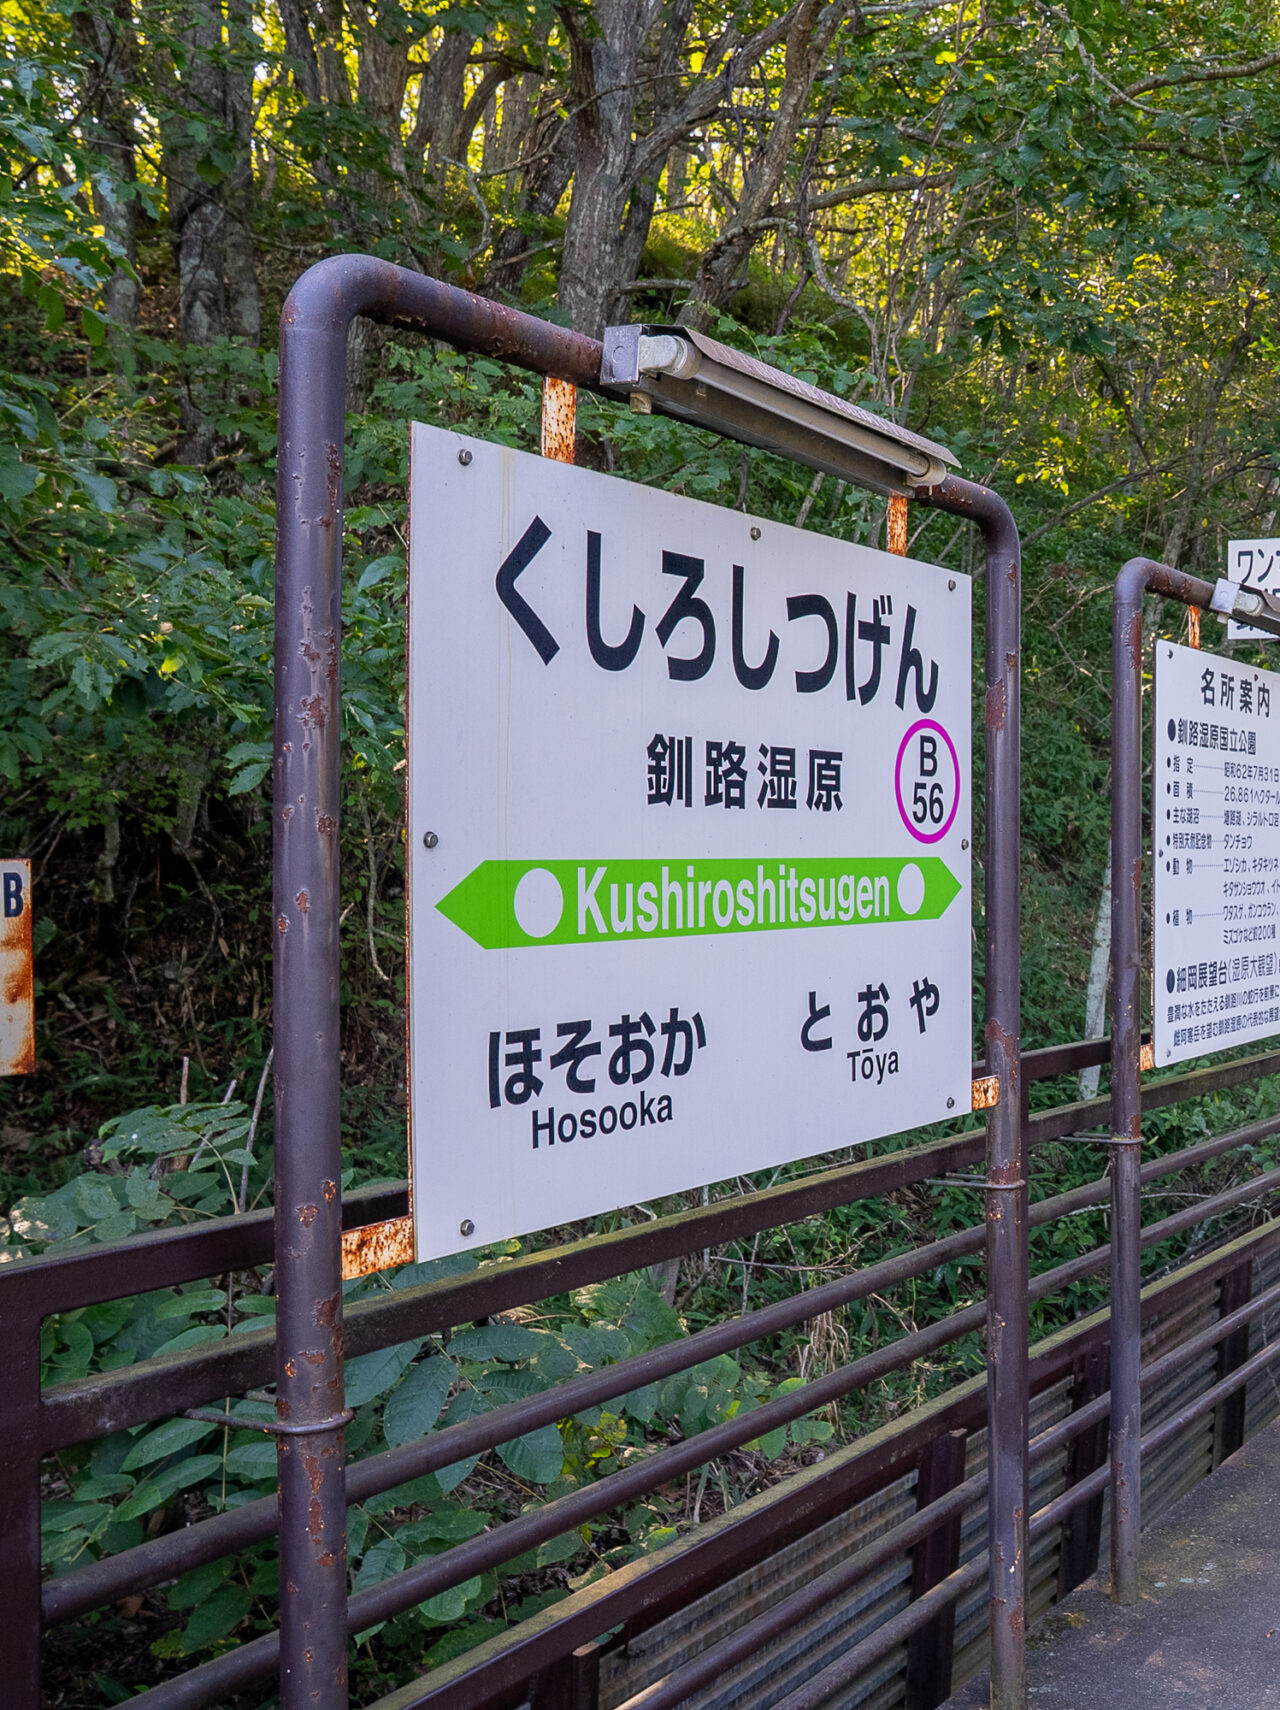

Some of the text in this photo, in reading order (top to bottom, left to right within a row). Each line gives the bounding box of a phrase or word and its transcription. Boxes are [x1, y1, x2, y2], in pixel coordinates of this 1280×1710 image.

[495, 515, 939, 714] くしろしつげん
[1200, 668, 1270, 718] 名所案内
[647, 733, 844, 812] 釧路湿原
[920, 736, 938, 777] B
[912, 783, 945, 825] 56
[1223, 832, 1252, 851] タンチョウ
[3, 872, 24, 917] B
[577, 866, 891, 934] Kushiroshitsugen
[801, 975, 942, 1052] とおや
[489, 1006, 706, 1109] ほそおか
[531, 1091, 675, 1149] Hosooka
